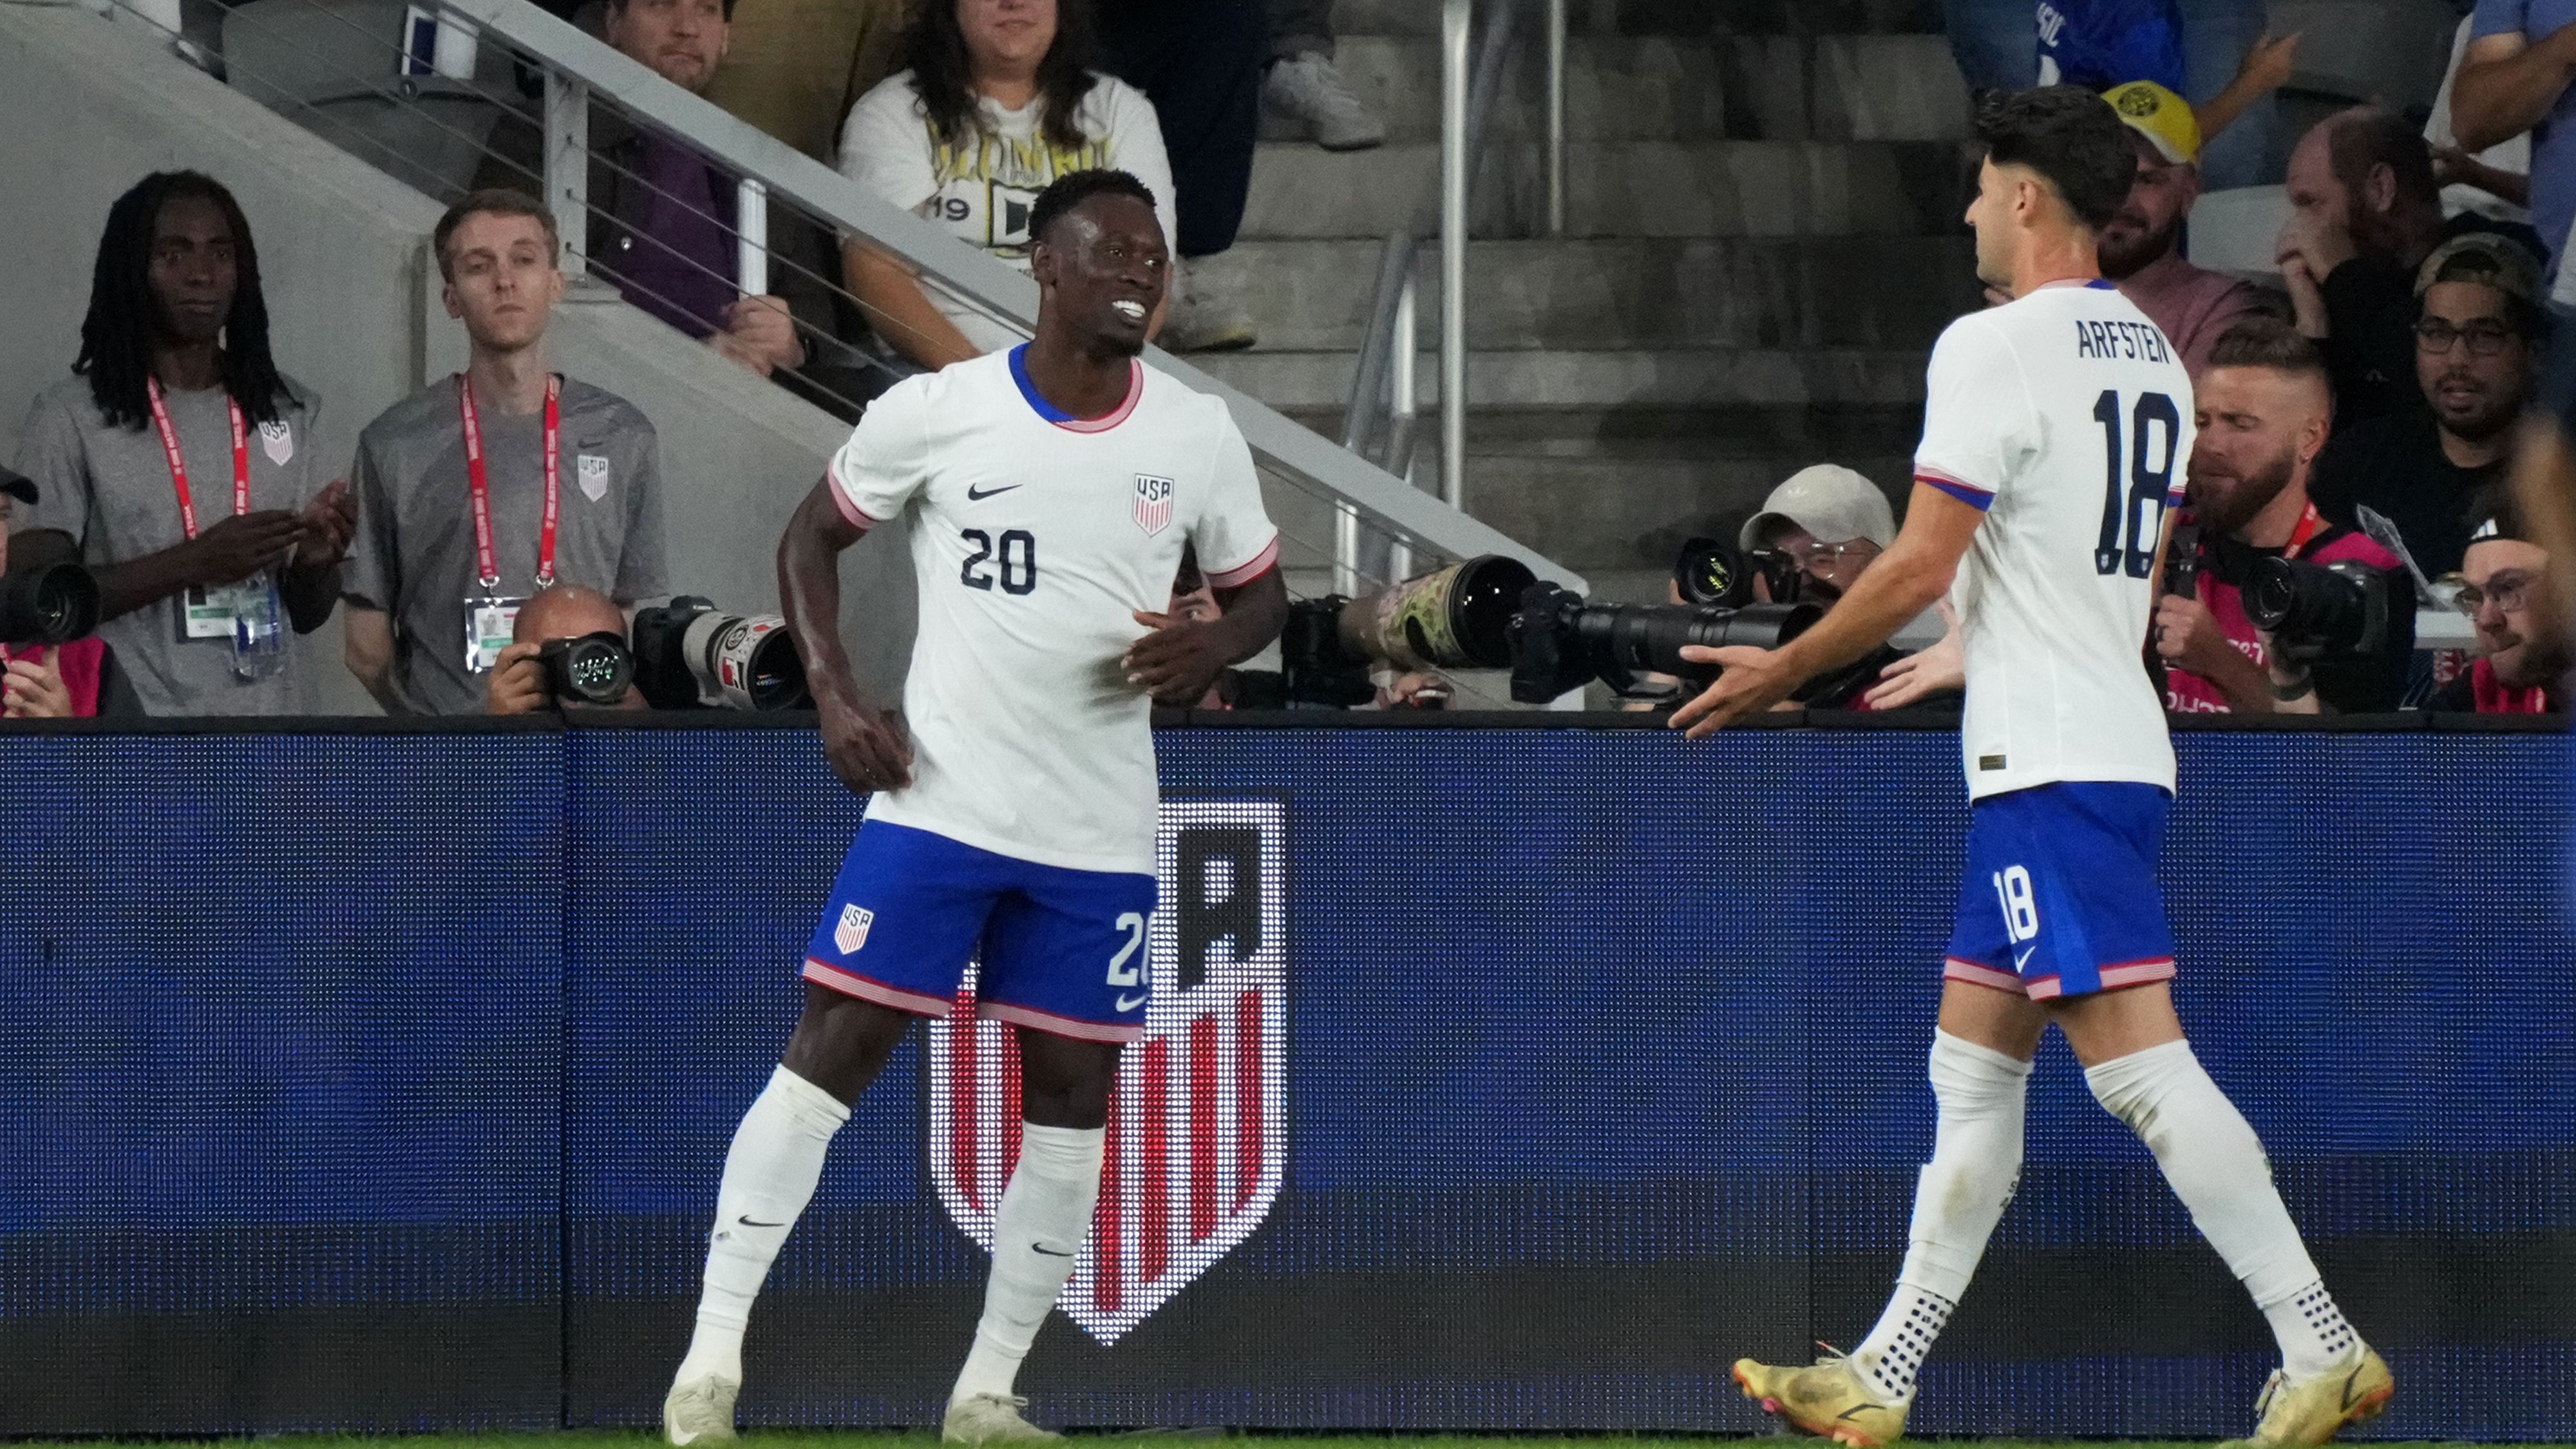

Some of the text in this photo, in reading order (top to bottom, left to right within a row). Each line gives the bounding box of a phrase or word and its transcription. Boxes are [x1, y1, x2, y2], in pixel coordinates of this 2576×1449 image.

[2076, 319, 2170, 365] ARFSTEN
[1137, 477, 1171, 502] USA
[2093, 389, 2180, 580] 18
[960, 528, 1037, 596] 20
[844, 905, 871, 927] USA
[1993, 864, 2039, 945] 18
[1106, 912, 1154, 987] 2
